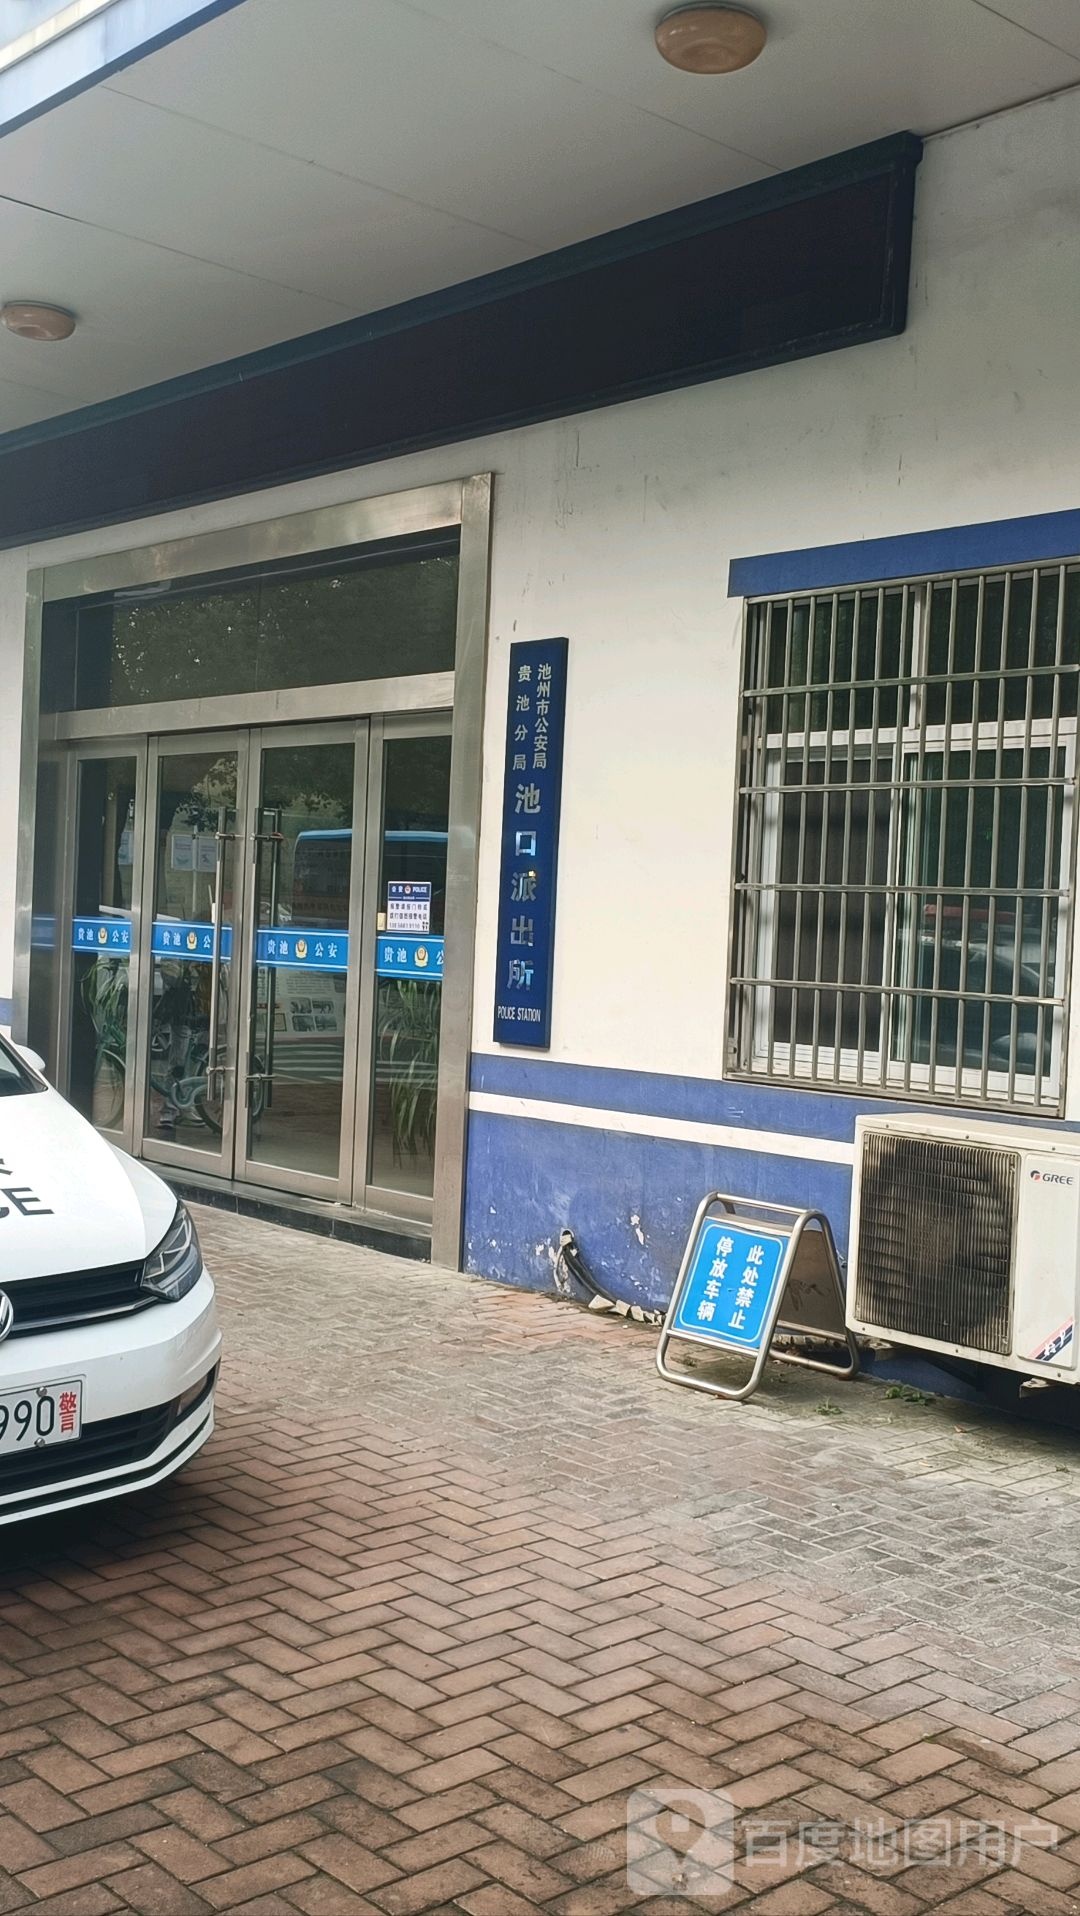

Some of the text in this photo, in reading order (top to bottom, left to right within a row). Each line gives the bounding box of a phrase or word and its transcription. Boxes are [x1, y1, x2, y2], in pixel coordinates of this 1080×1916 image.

[512, 664, 532, 771] 贵池分局
[533, 662, 552, 769] 池州市公安局
[507, 783, 541, 990] 池口派出所
[315, 942, 338, 958] 公安
[497, 1005, 541, 1022] POLICE STATION
[1042, 1173, 1074, 1186] GREE
[697, 1236, 735, 1322] 停放车辆
[728, 1245, 765, 1330] 此处禁止
